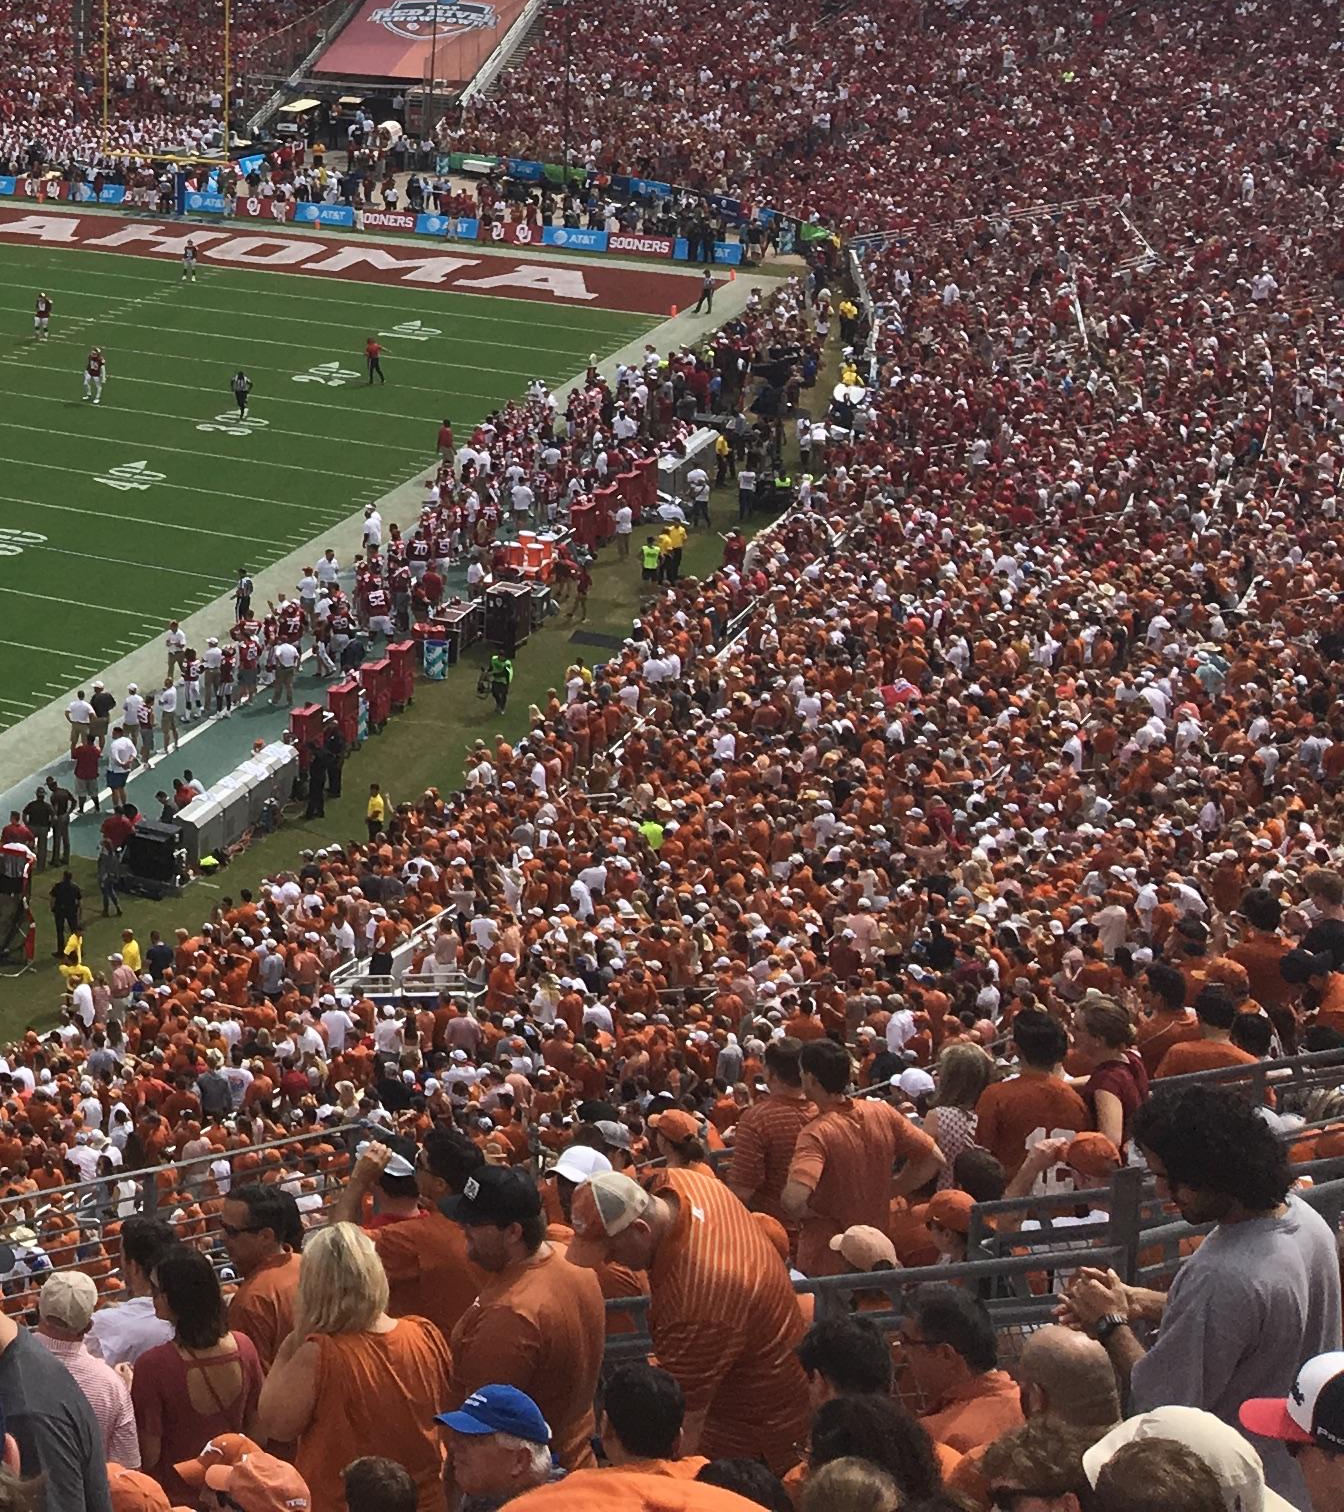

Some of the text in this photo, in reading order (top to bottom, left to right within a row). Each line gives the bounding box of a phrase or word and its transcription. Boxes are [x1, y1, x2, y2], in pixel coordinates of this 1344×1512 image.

[321, 211, 346, 220] AT&T
[363, 213, 413, 228] OONERS
[569, 235, 596, 245] AT&T
[609, 237, 670, 253] SOONERS
